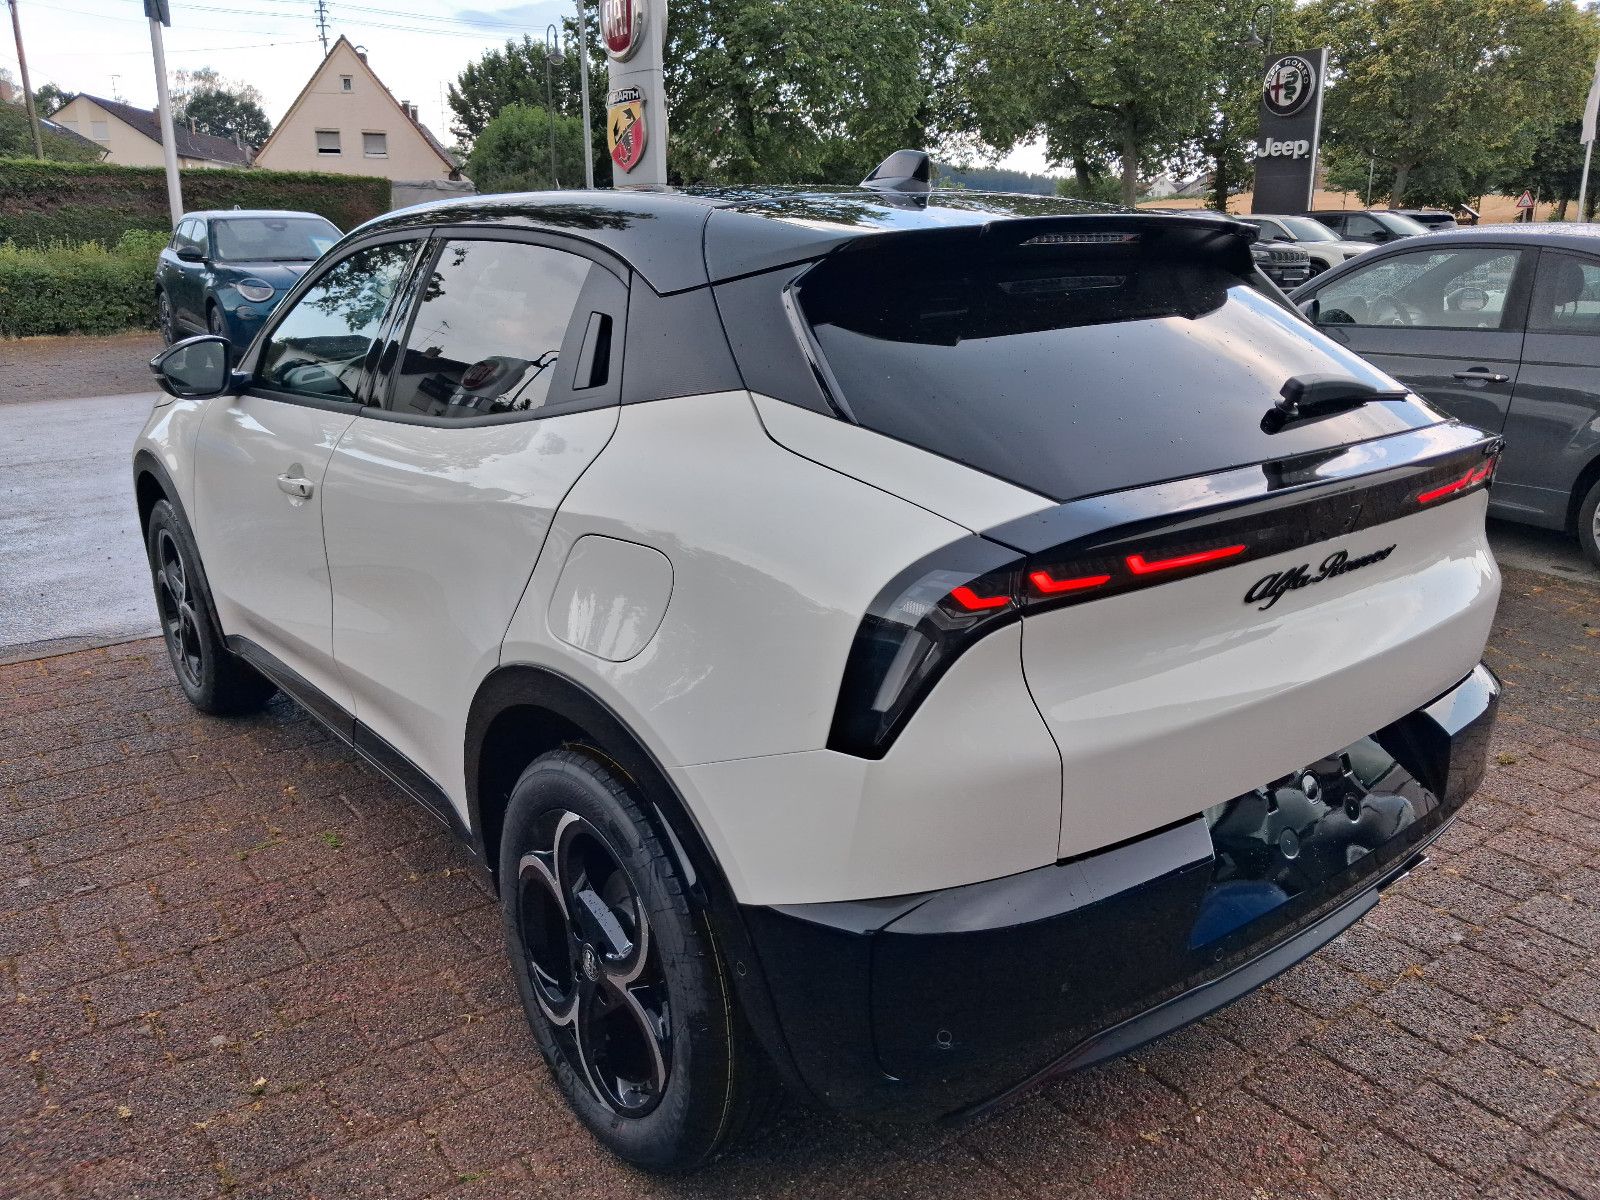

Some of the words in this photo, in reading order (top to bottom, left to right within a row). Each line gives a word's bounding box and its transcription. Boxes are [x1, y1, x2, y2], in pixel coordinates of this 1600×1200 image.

[1265, 64, 1282, 90] ALFA
[1285, 58, 1309, 85] ROMEO
[609, 90, 639, 103] BARTH
[1243, 563, 1312, 611] Alfa
